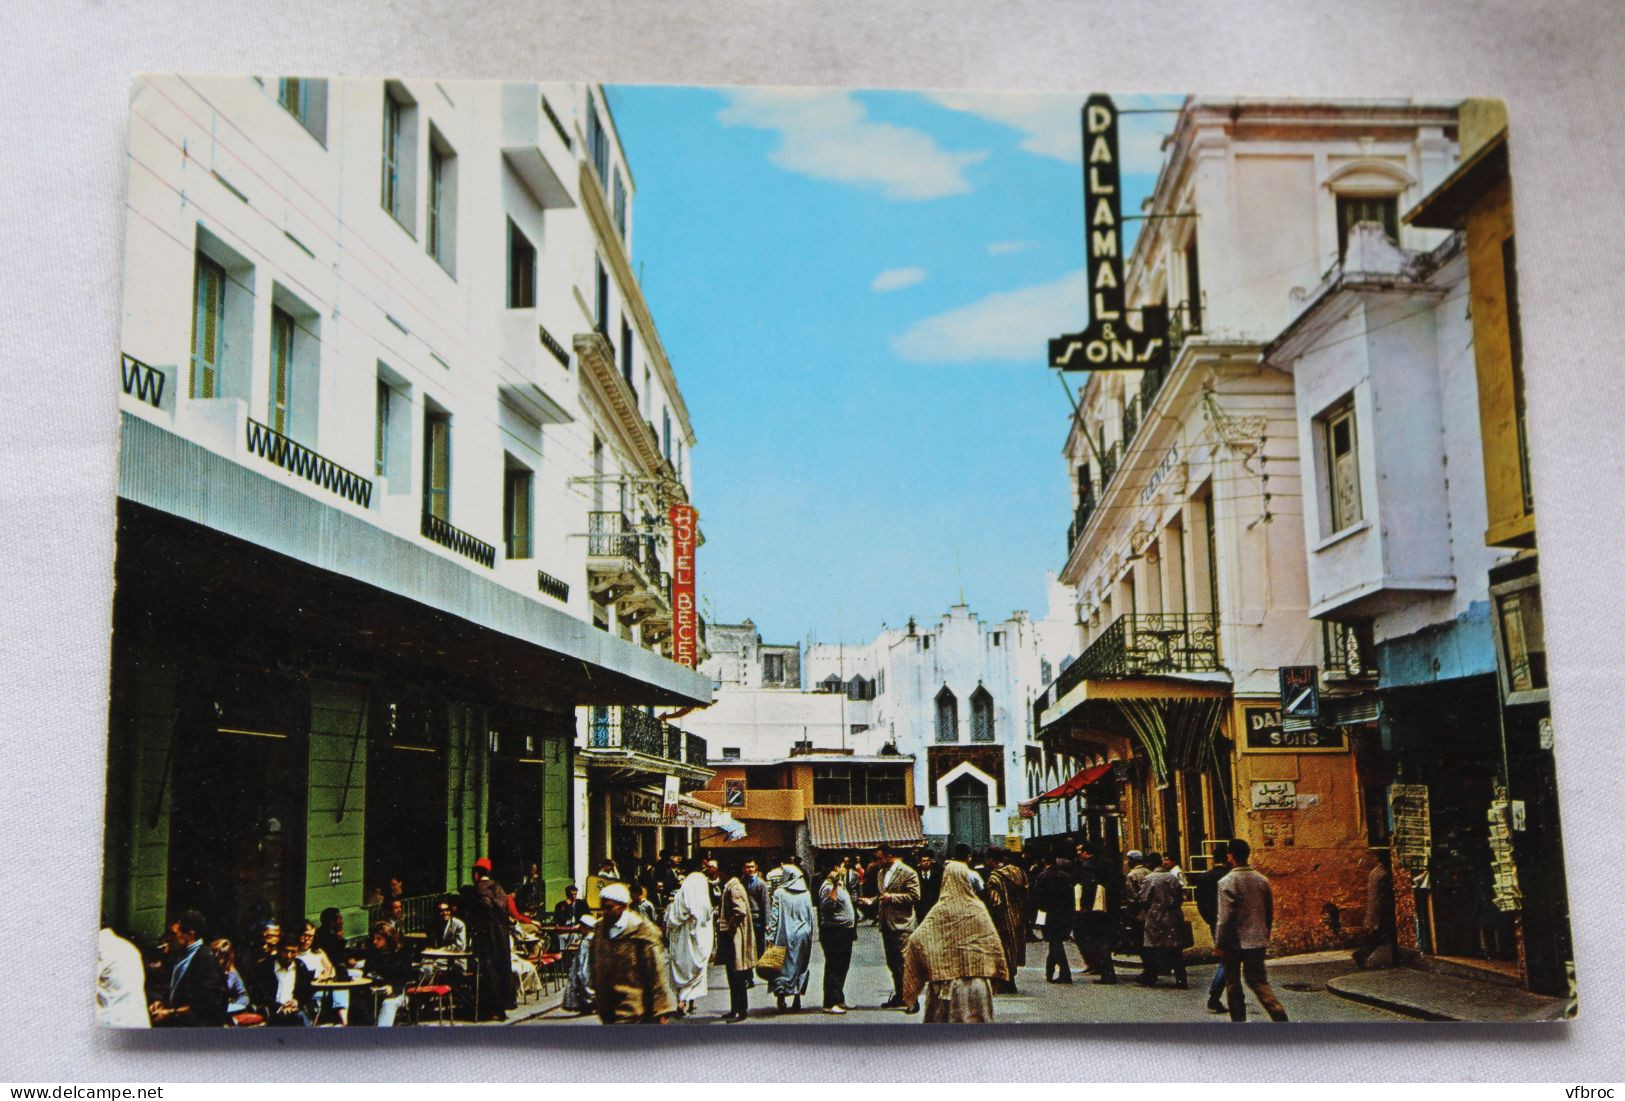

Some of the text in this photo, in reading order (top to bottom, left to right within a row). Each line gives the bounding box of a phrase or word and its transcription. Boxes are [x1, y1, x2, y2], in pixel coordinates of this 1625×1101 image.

[1087, 104, 1120, 321] DALAMAL
[1055, 339, 1162, 364] SONS
[1102, 322, 1117, 341] &
[675, 508, 692, 585] HOTEL
